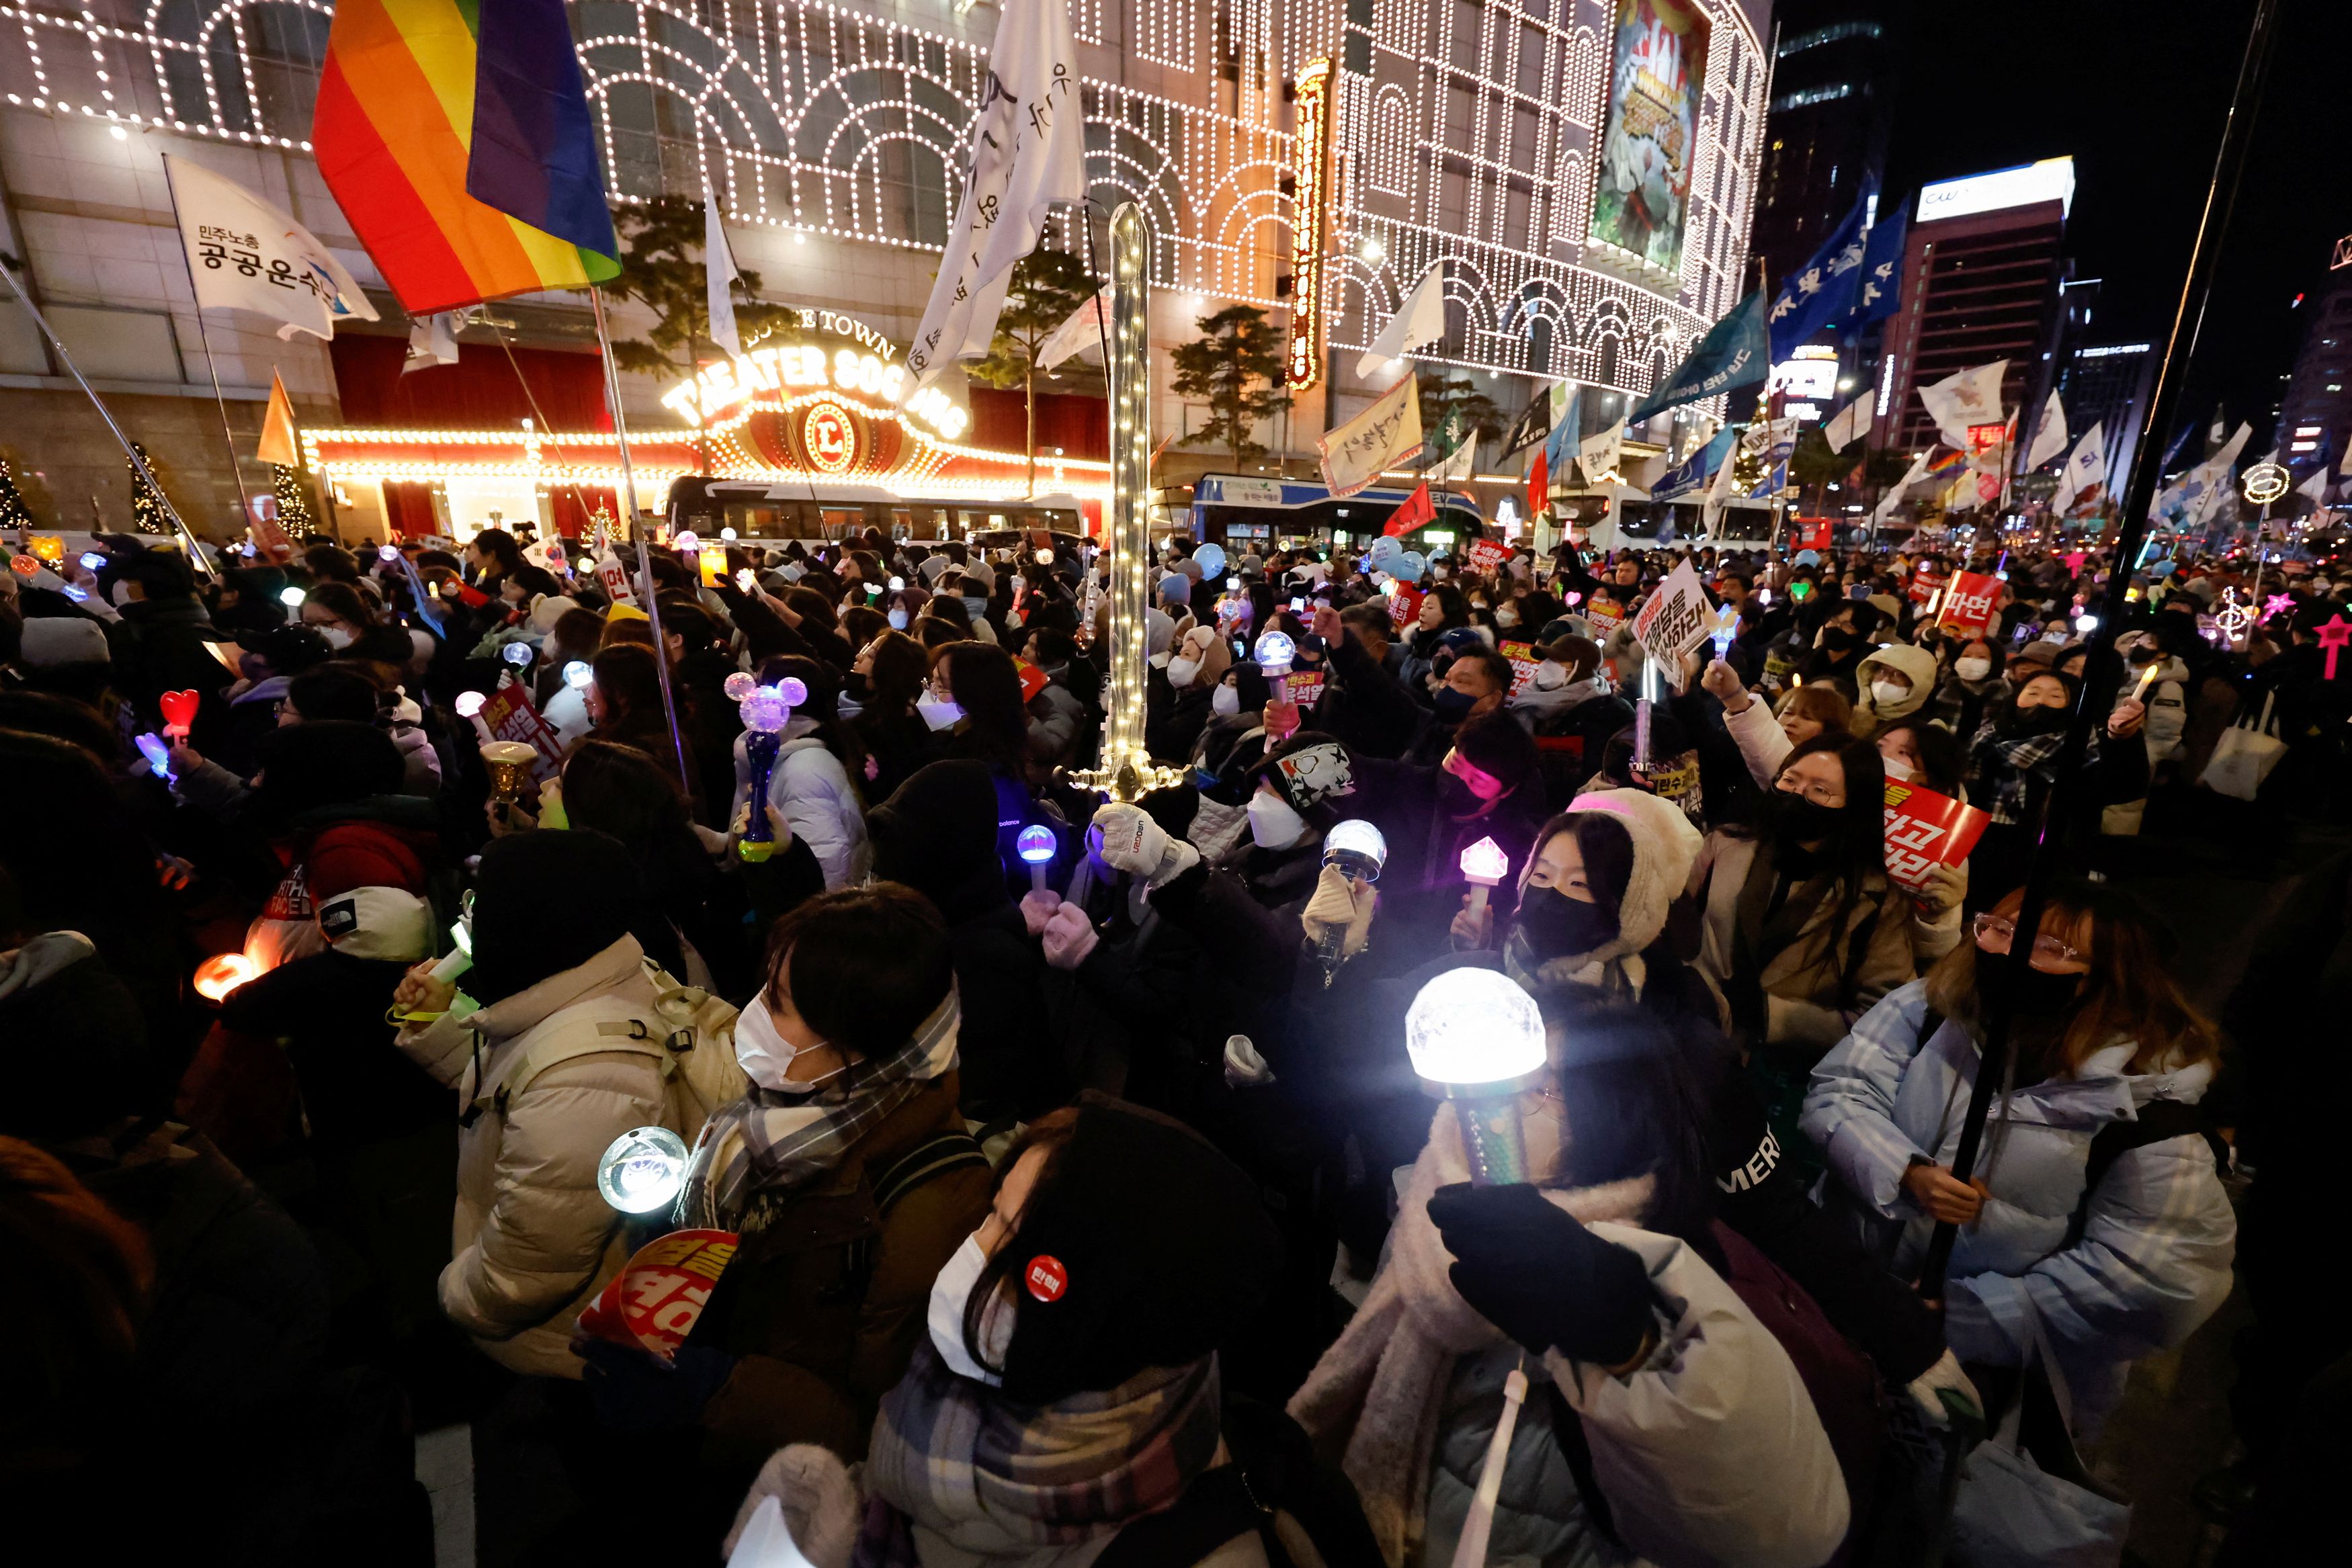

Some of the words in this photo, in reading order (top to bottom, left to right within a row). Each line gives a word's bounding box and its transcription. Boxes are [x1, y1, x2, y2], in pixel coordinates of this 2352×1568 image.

[199, 226, 259, 249] 민주노총
[819, 310, 896, 361] TOWN
[834, 349, 967, 439] SOGNG
[817, 421, 843, 453] L
[601, 567, 628, 600] 면
[1947, 592, 1992, 621] 파면
[1644, 589, 1686, 657] 국힘당을
[1502, 644, 1540, 662] 윤석
[1884, 783, 1913, 807] 을
[999, 819, 1020, 827] balance
[271, 896, 300, 915] FACE
[1716, 1121, 1781, 1194] MER
[1031, 1266, 1060, 1294] 탄핵
